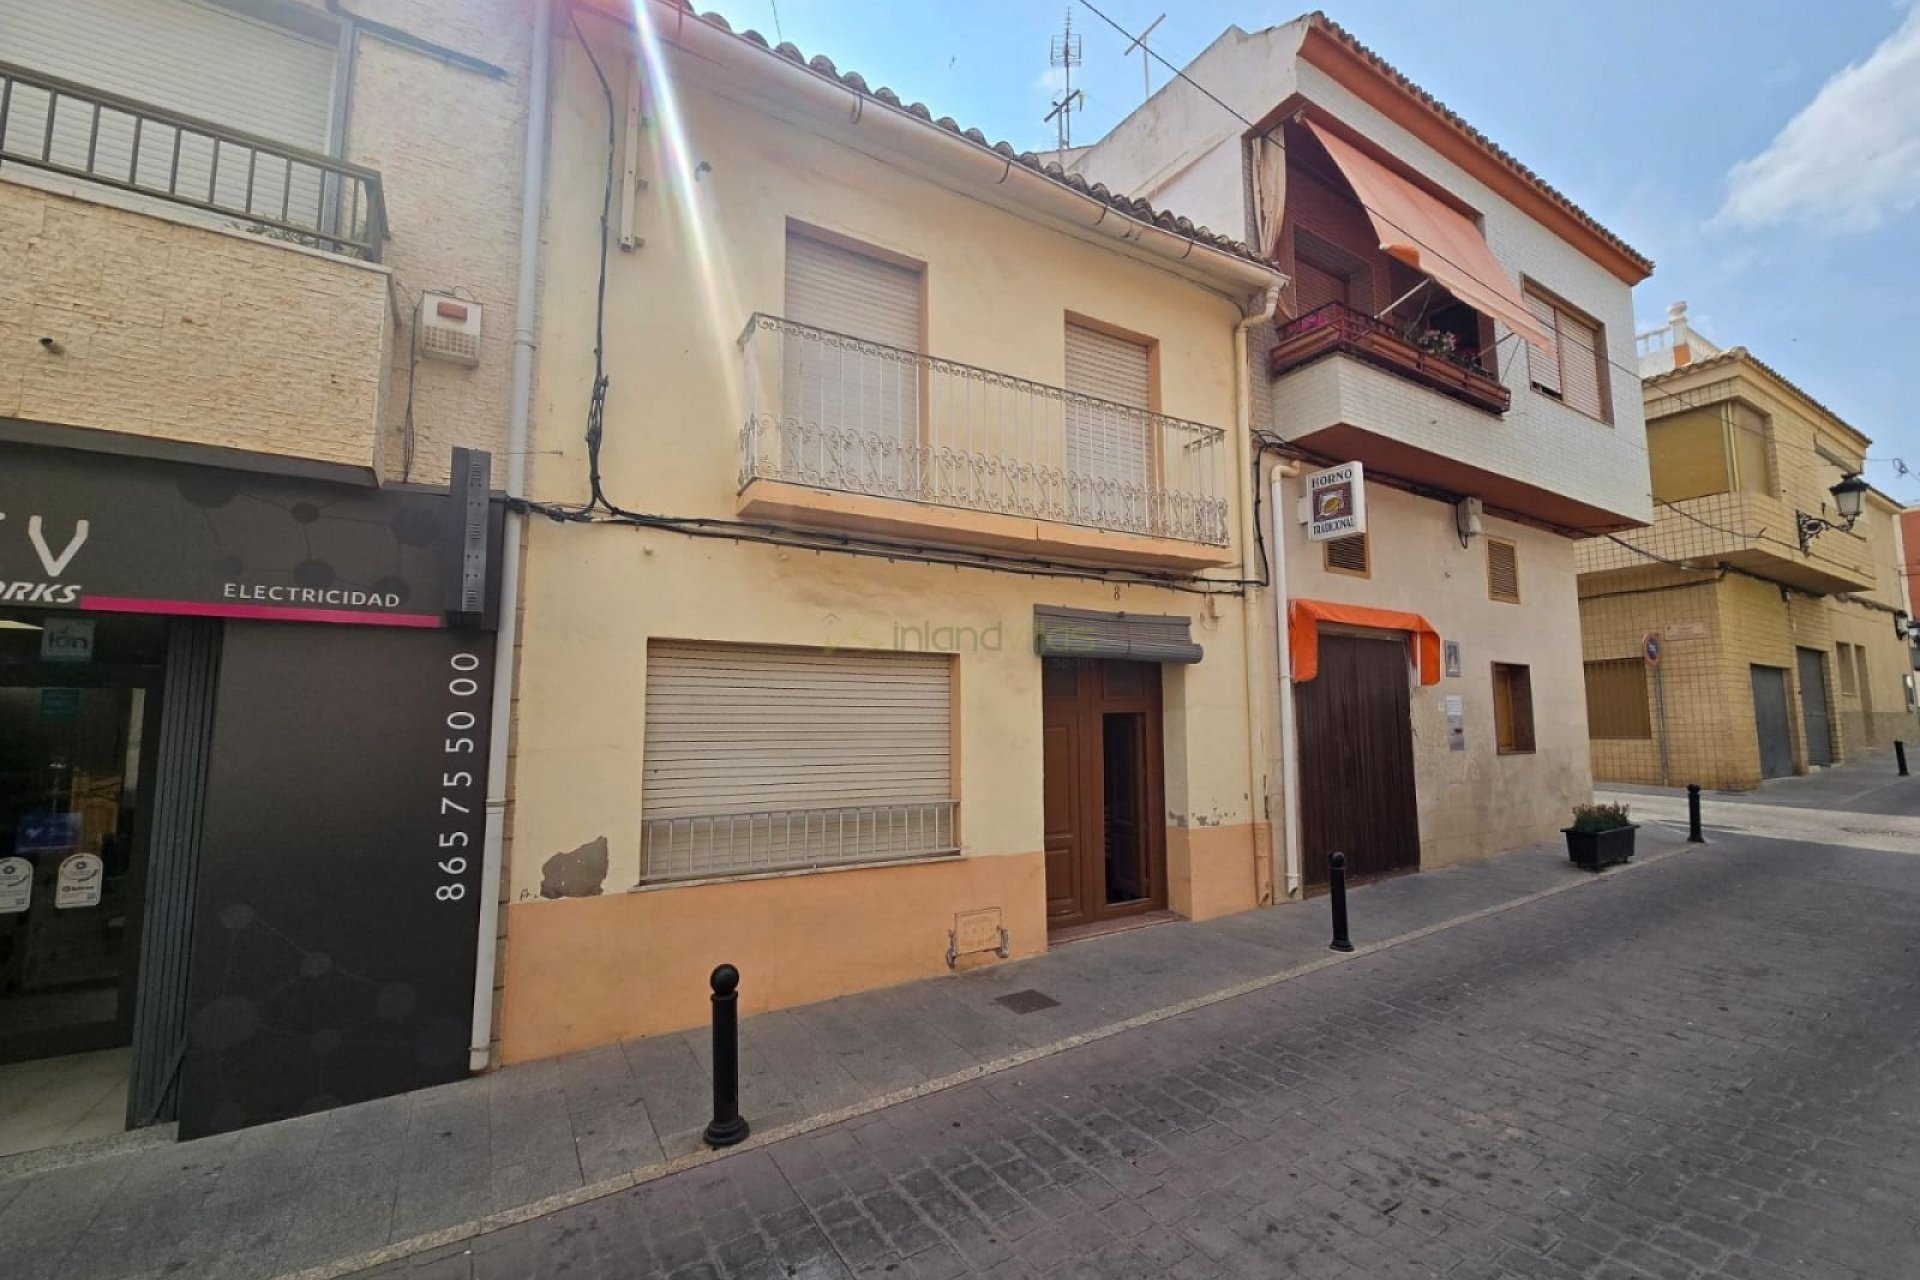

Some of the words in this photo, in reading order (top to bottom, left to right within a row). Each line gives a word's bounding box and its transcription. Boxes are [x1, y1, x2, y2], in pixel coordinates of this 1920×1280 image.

[1312, 468, 1352, 488] HORNO
[0, 512, 89, 577] V
[0, 581, 82, 603] RKS
[223, 583, 400, 607] ELECTRICIDAD
